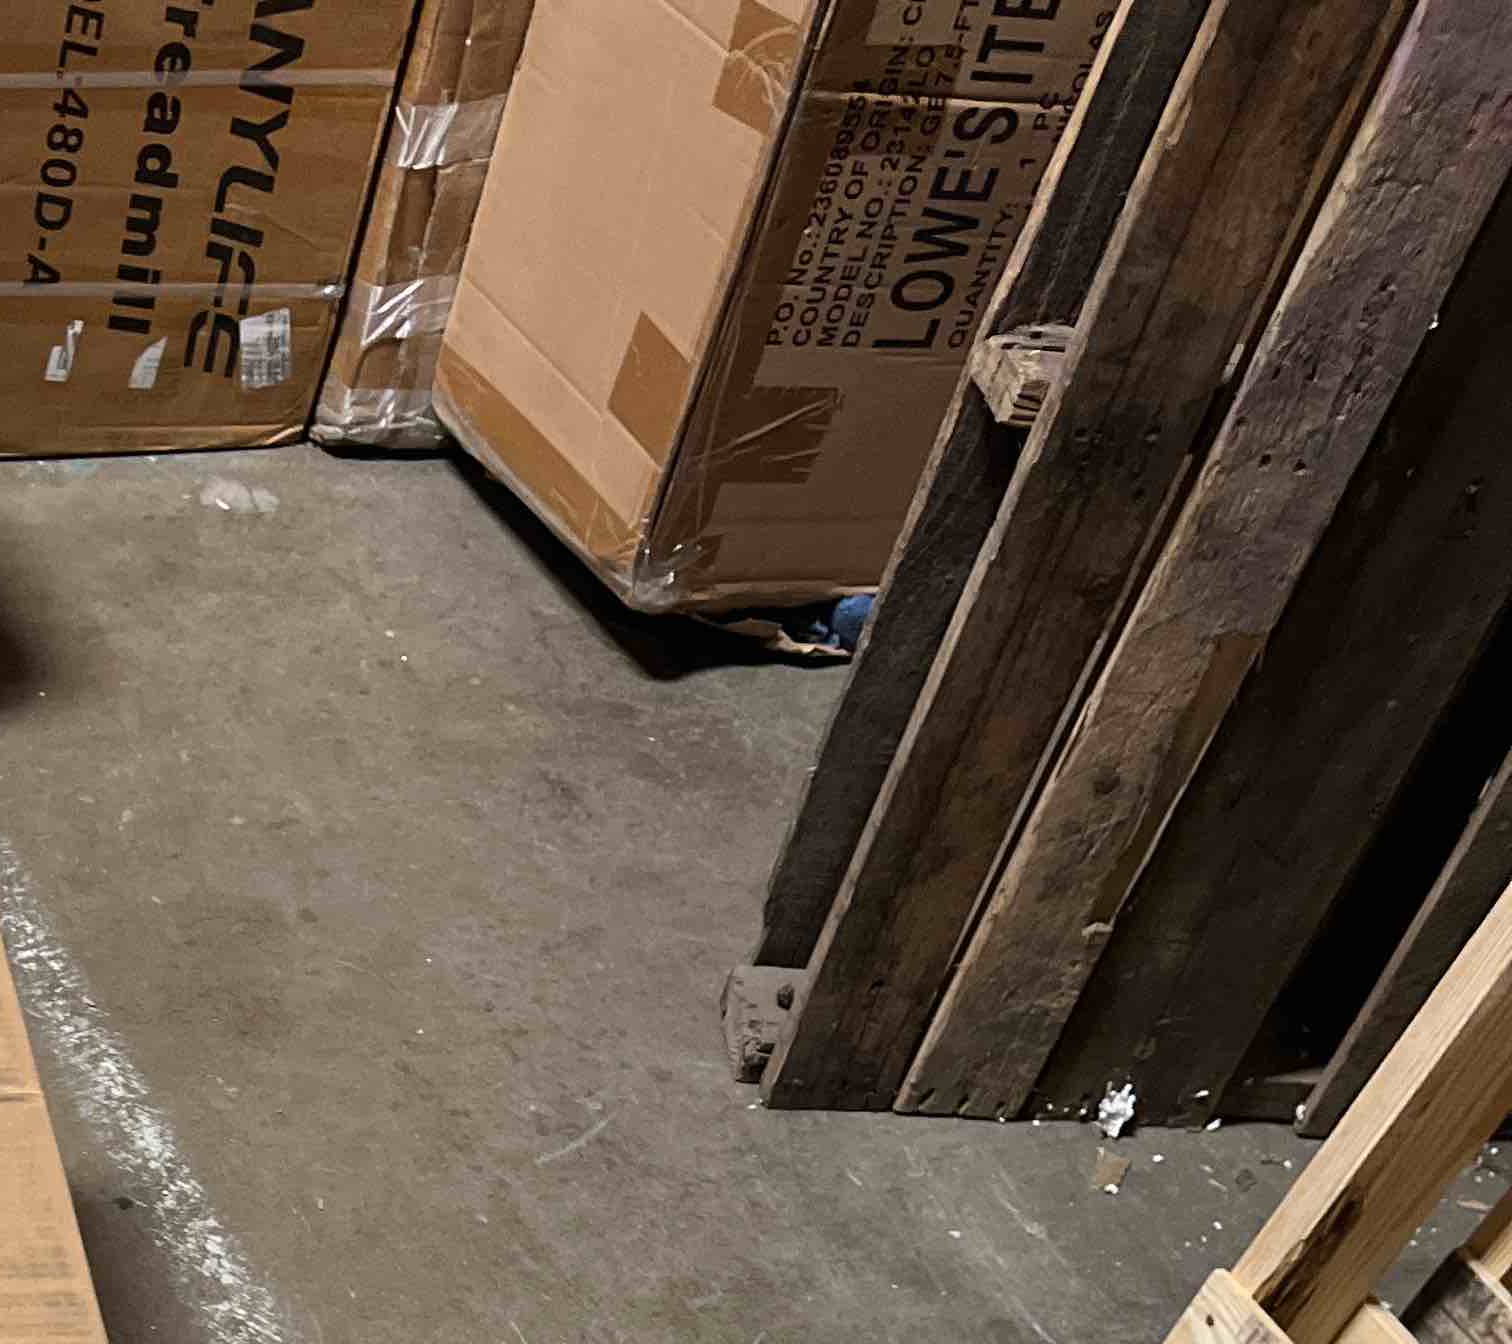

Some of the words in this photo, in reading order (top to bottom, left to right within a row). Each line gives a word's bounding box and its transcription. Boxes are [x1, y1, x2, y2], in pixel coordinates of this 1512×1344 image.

[23, 0, 104, 287] EL:480D-A
[108, 0, 214, 335] readmill
[793, 208, 854, 346] COUNTRY
[844, 160, 869, 200] OF
[841, 148, 930, 347] DESCRIPTION:
[872, 106, 1019, 349] LOWE'S
[818, 247, 867, 346] MODEL
